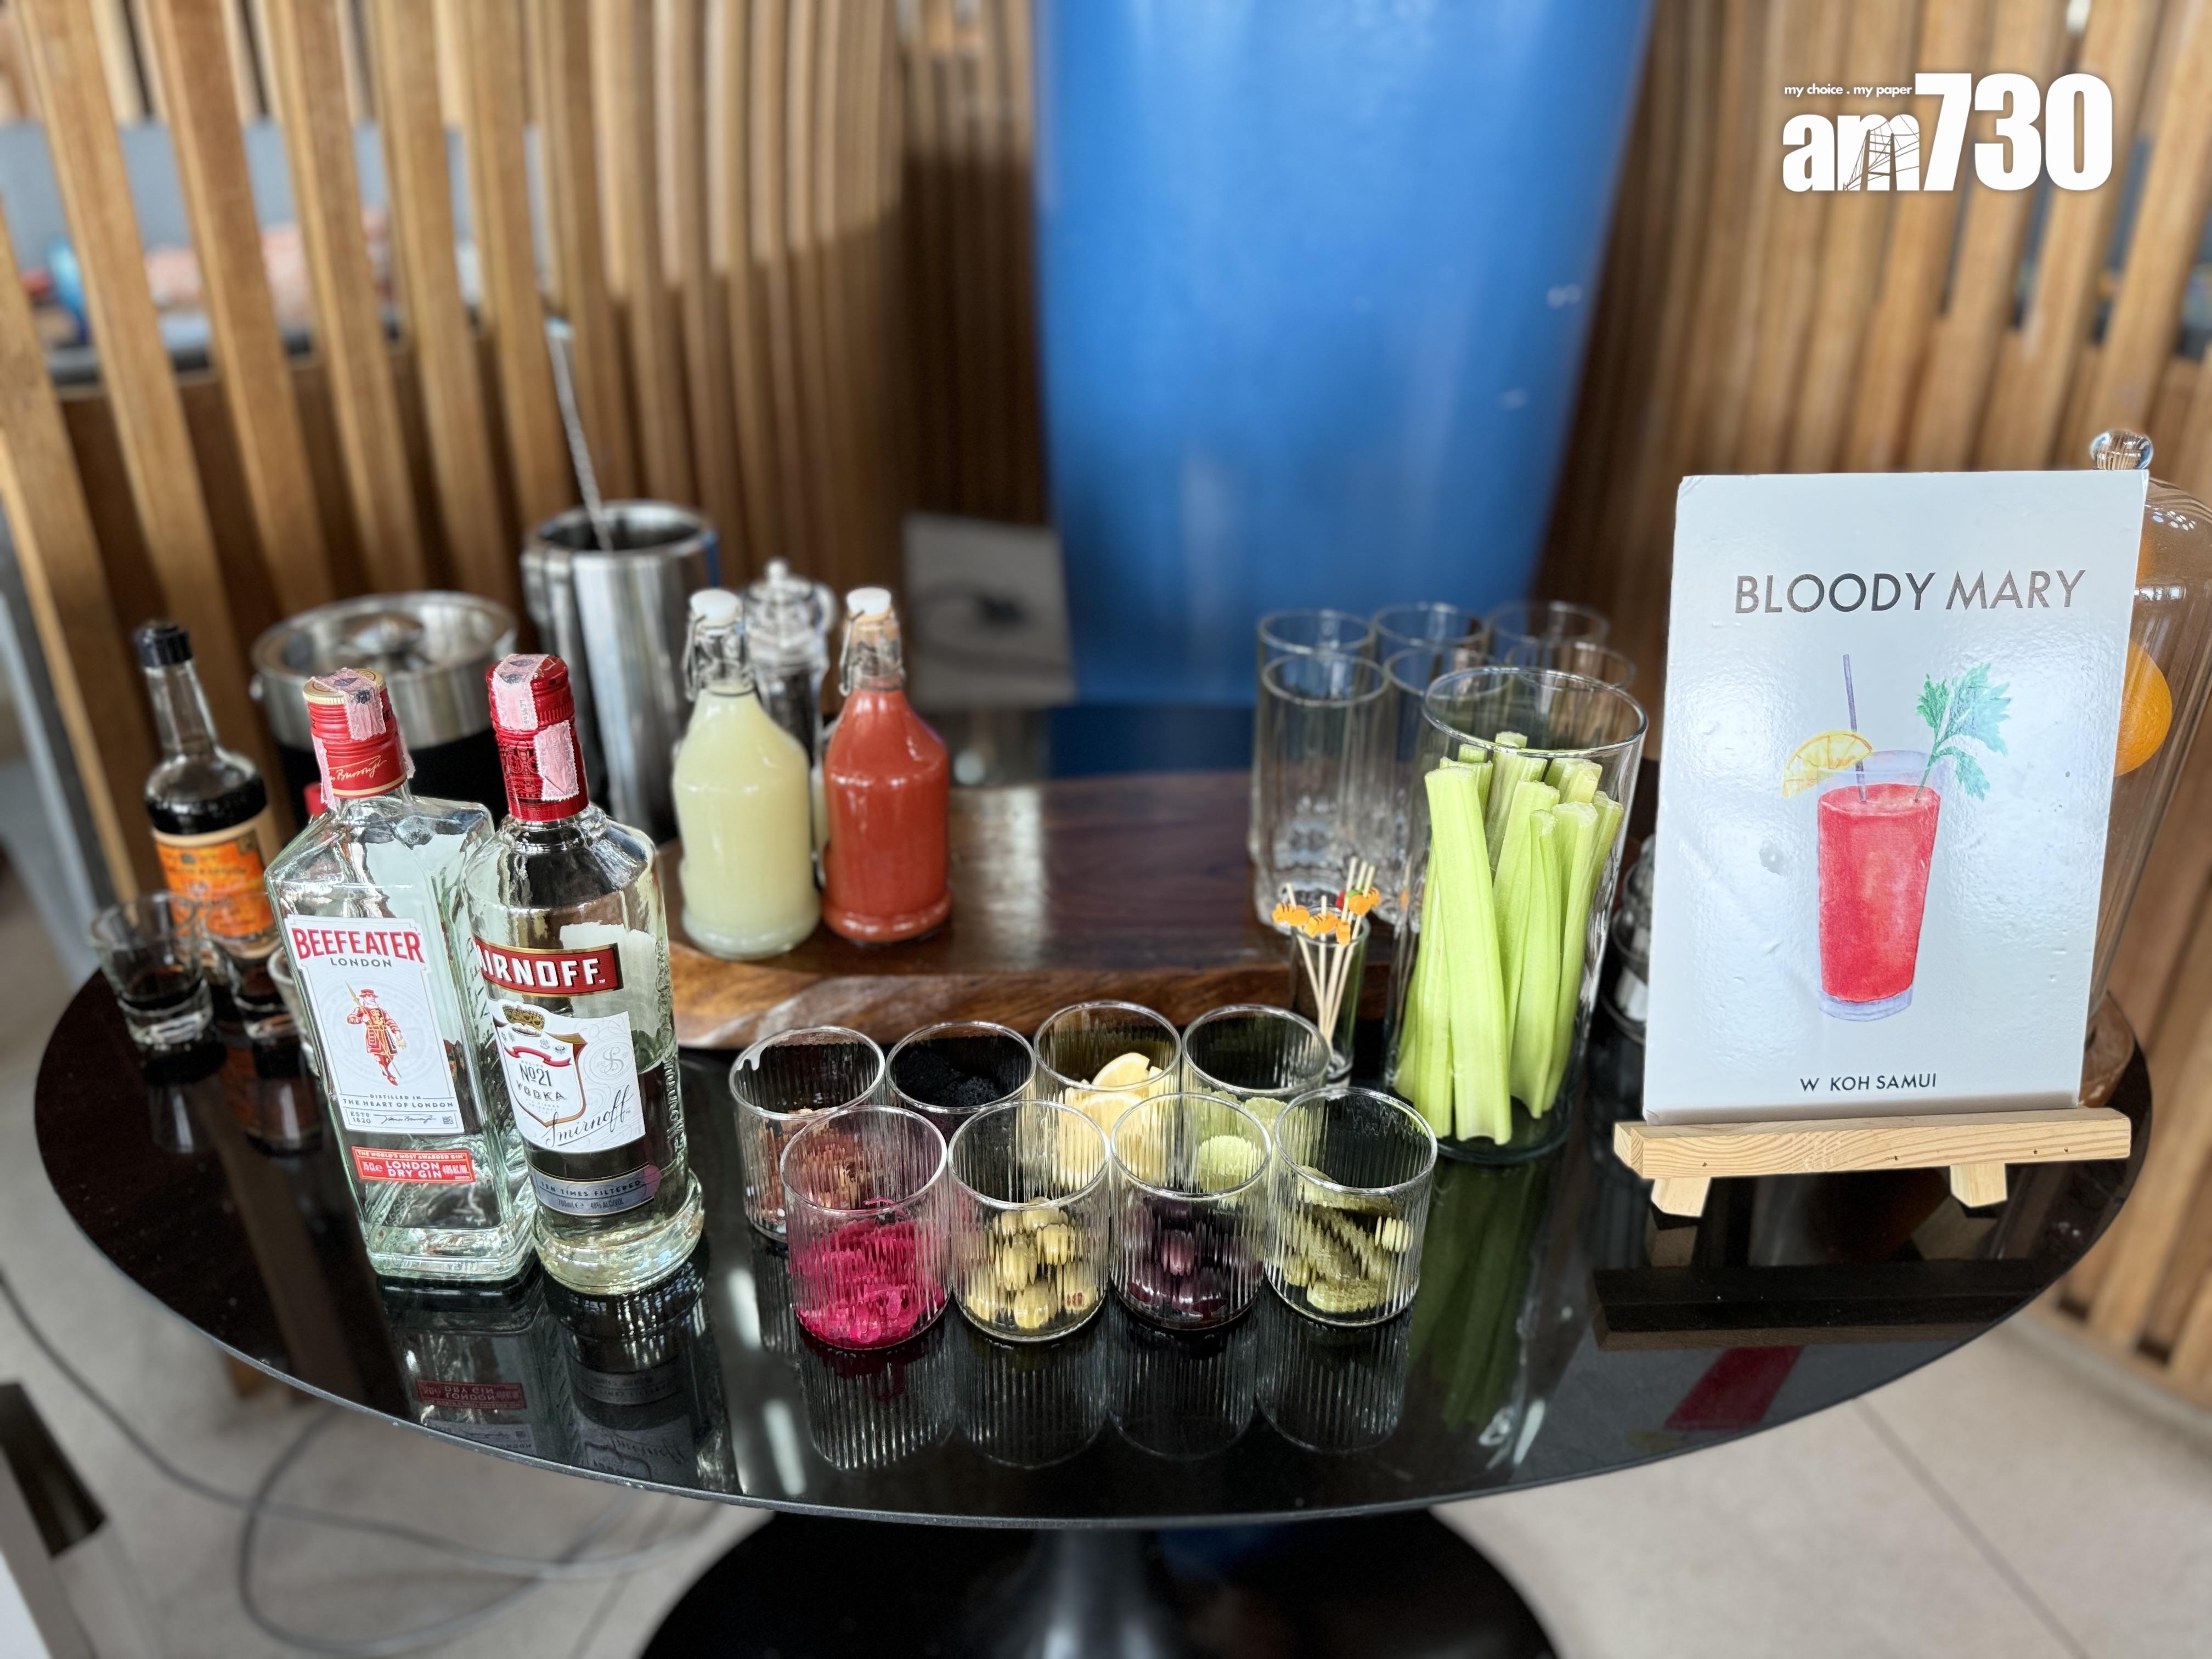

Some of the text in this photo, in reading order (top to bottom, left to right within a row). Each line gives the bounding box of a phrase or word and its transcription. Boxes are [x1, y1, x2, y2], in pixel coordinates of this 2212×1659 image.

[1735, 569, 2086, 614] BLOODY MARY
[291, 927, 425, 964] BEEFEATER
[330, 957, 392, 967] LONDON
[516, 1080, 566, 1101] VODKA
[1800, 1073, 1936, 1092] W KOH SAMUI
[541, 1084, 633, 1148] Smirnoff
[385, 1160, 440, 1170] LONDON
[388, 1169, 443, 1179] DRY GIN
[561, 1188, 589, 1197] TIMES
[595, 1180, 641, 1197] FILTERED
